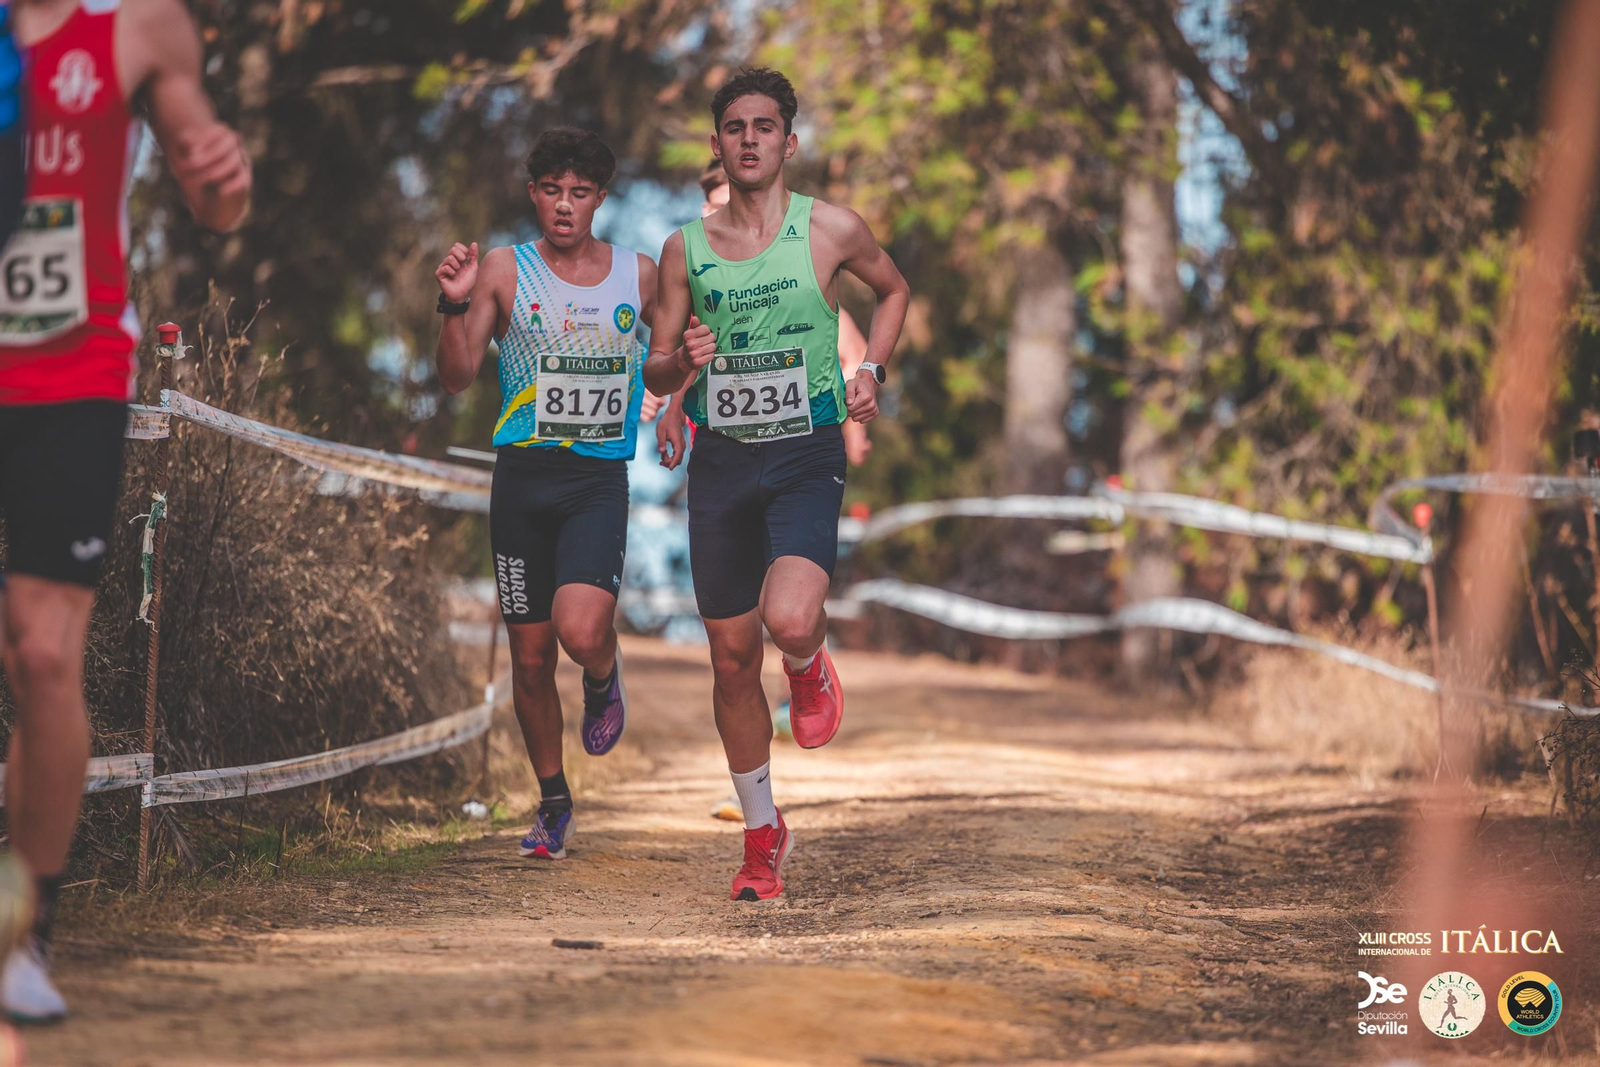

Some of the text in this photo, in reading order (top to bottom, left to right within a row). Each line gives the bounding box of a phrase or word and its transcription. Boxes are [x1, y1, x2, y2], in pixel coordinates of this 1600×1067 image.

[728, 277, 798, 301] Fundación
[729, 294, 779, 313] Unicaja
[731, 315, 754, 326] Jaén
[566, 357, 609, 370] ITÁLICA
[732, 355, 779, 368] ITÁLICA
[545, 387, 622, 417] 8176
[717, 381, 802, 418] 8234
